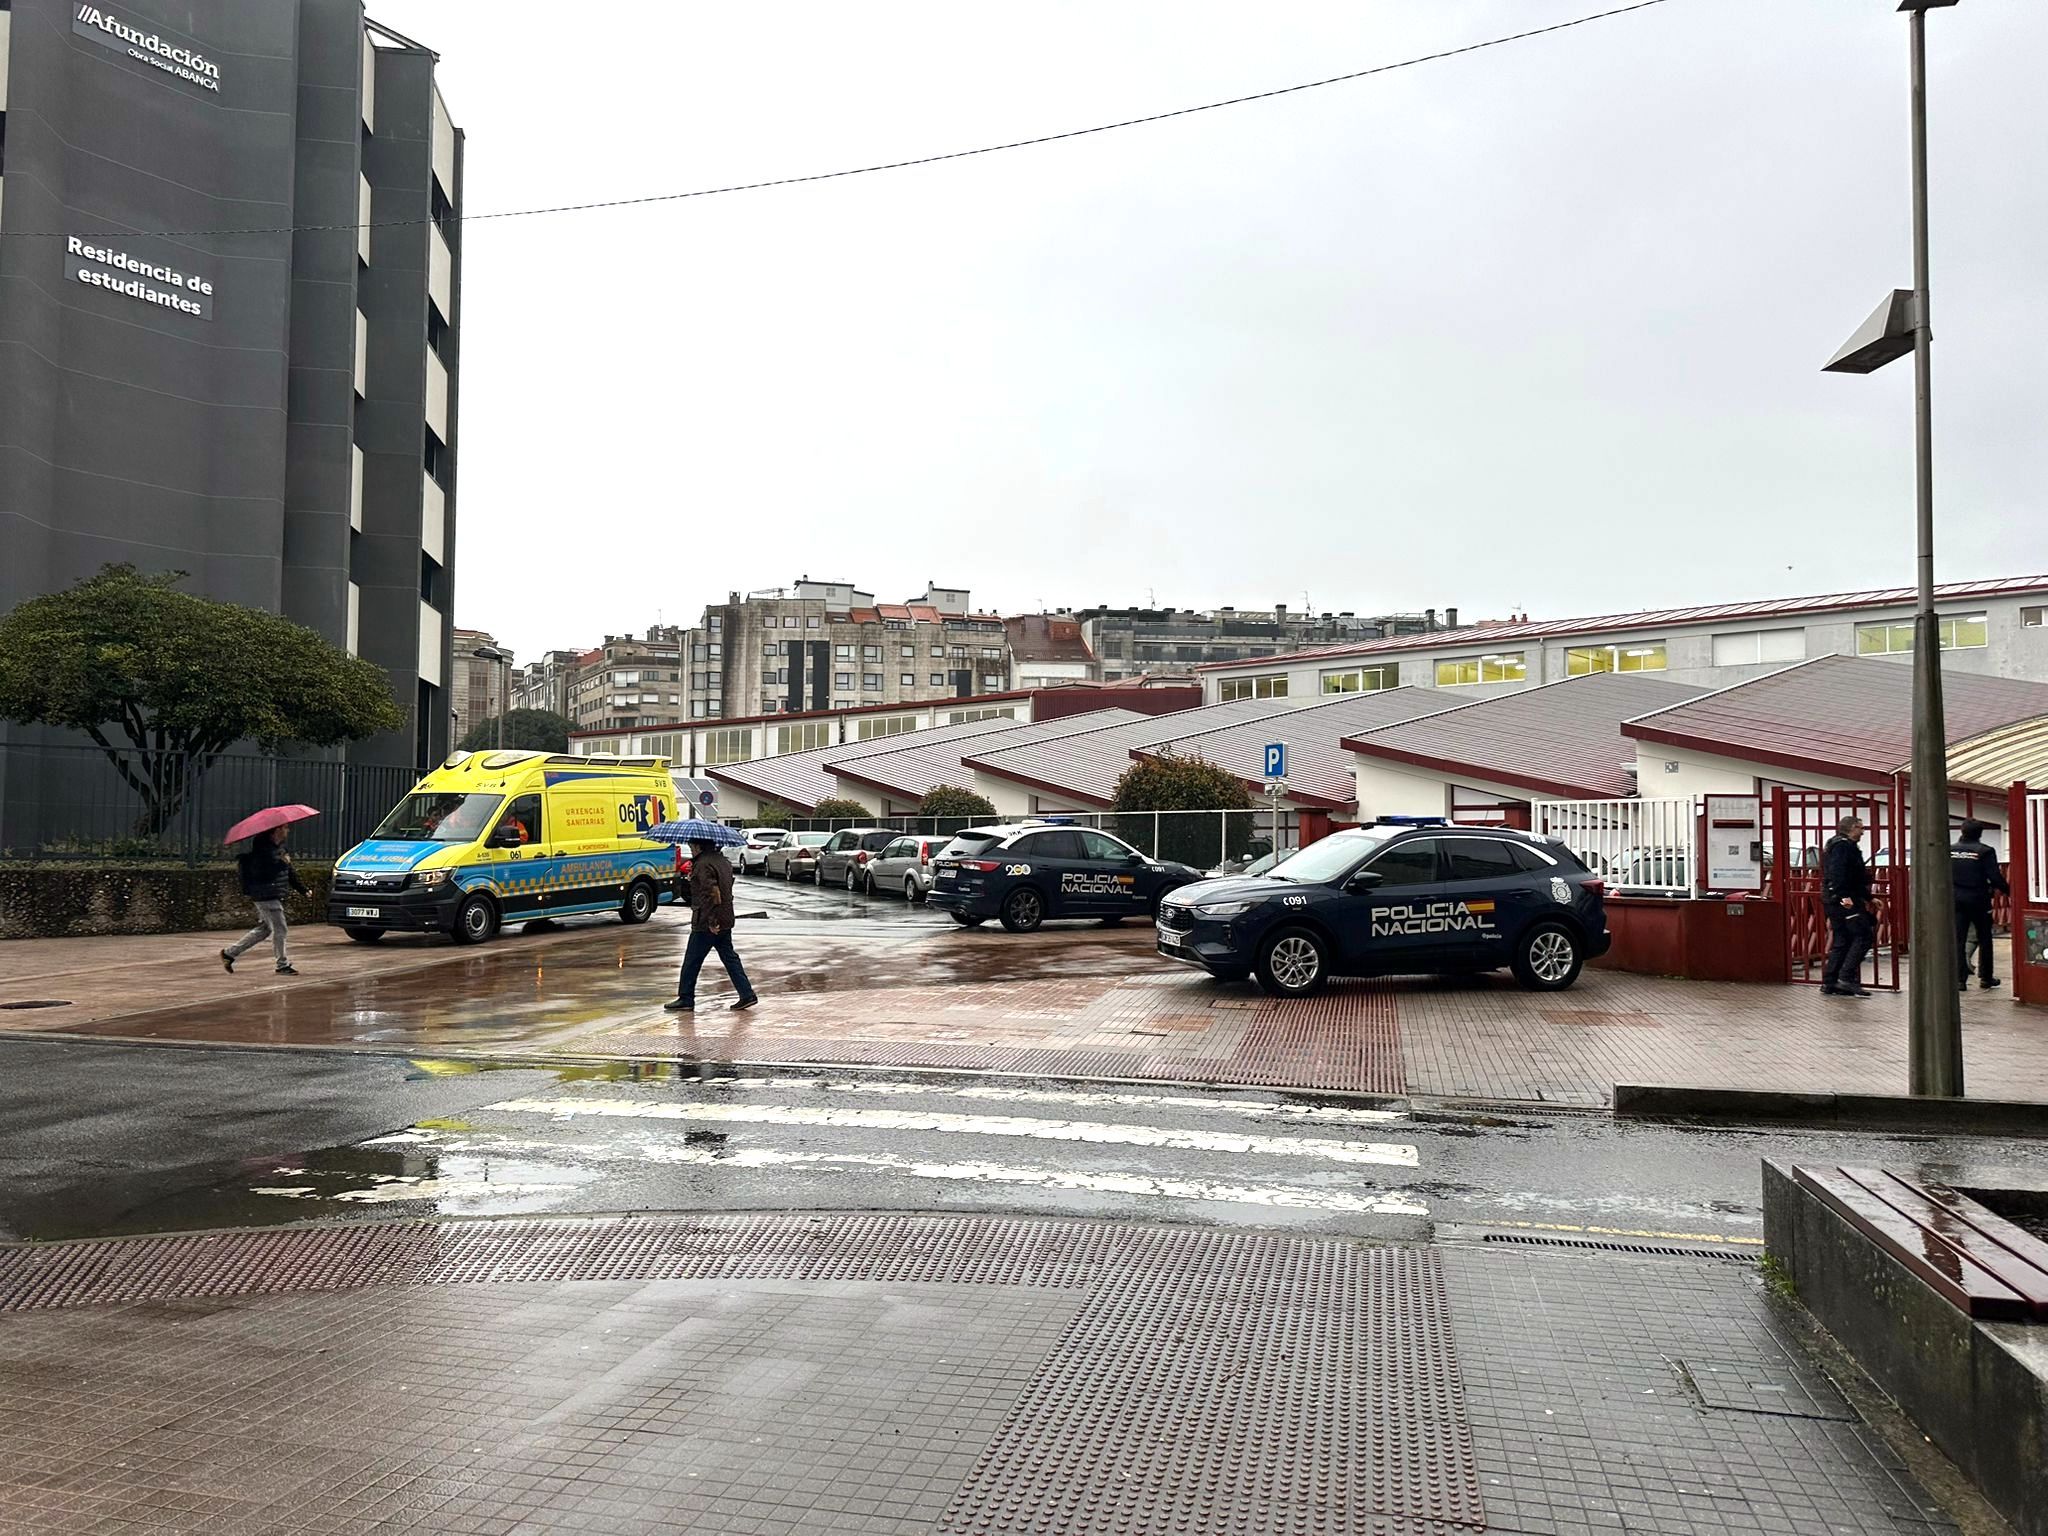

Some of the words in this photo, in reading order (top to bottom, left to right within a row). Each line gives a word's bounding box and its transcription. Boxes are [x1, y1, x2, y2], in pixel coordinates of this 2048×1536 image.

[127, 48, 149, 63] Obra
[149, 56, 175, 74] Social
[174, 66, 219, 91] ABANCA
[67, 236, 183, 287] Residencia
[186, 275, 213, 296] de
[77, 268, 201, 315] estudiantes
[1268, 748, 1280, 773] P
[654, 779, 667, 788] SVB
[565, 807, 605, 816] URXENCIAS
[619, 803, 642, 823] 061
[566, 818, 605, 827] SANITARIAS
[510, 851, 522, 860] 061
[561, 860, 613, 874] AMBULANCIA
[1062, 873, 1120, 884] POLICIA
[1061, 883, 1133, 895] NACIONAL
[1371, 901, 1470, 921] POLICIA
[1371, 915, 1495, 937] NACIONAL
